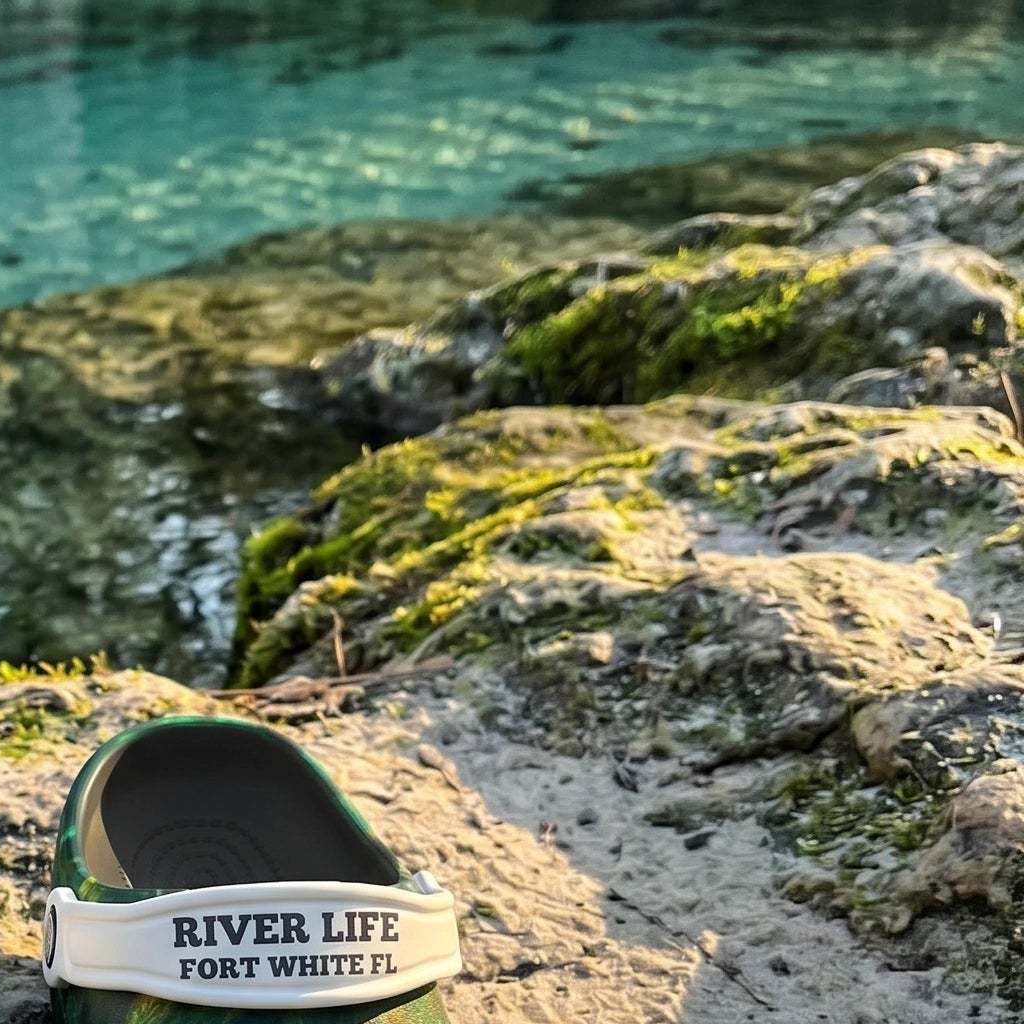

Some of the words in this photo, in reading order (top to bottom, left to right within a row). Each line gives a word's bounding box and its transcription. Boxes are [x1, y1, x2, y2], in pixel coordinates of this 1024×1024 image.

[173, 912, 310, 948] RIVER
[321, 911, 399, 943] LIFE
[179, 956, 260, 980] FORT
[267, 953, 363, 978] WHITE
[370, 953, 398, 975] FL
